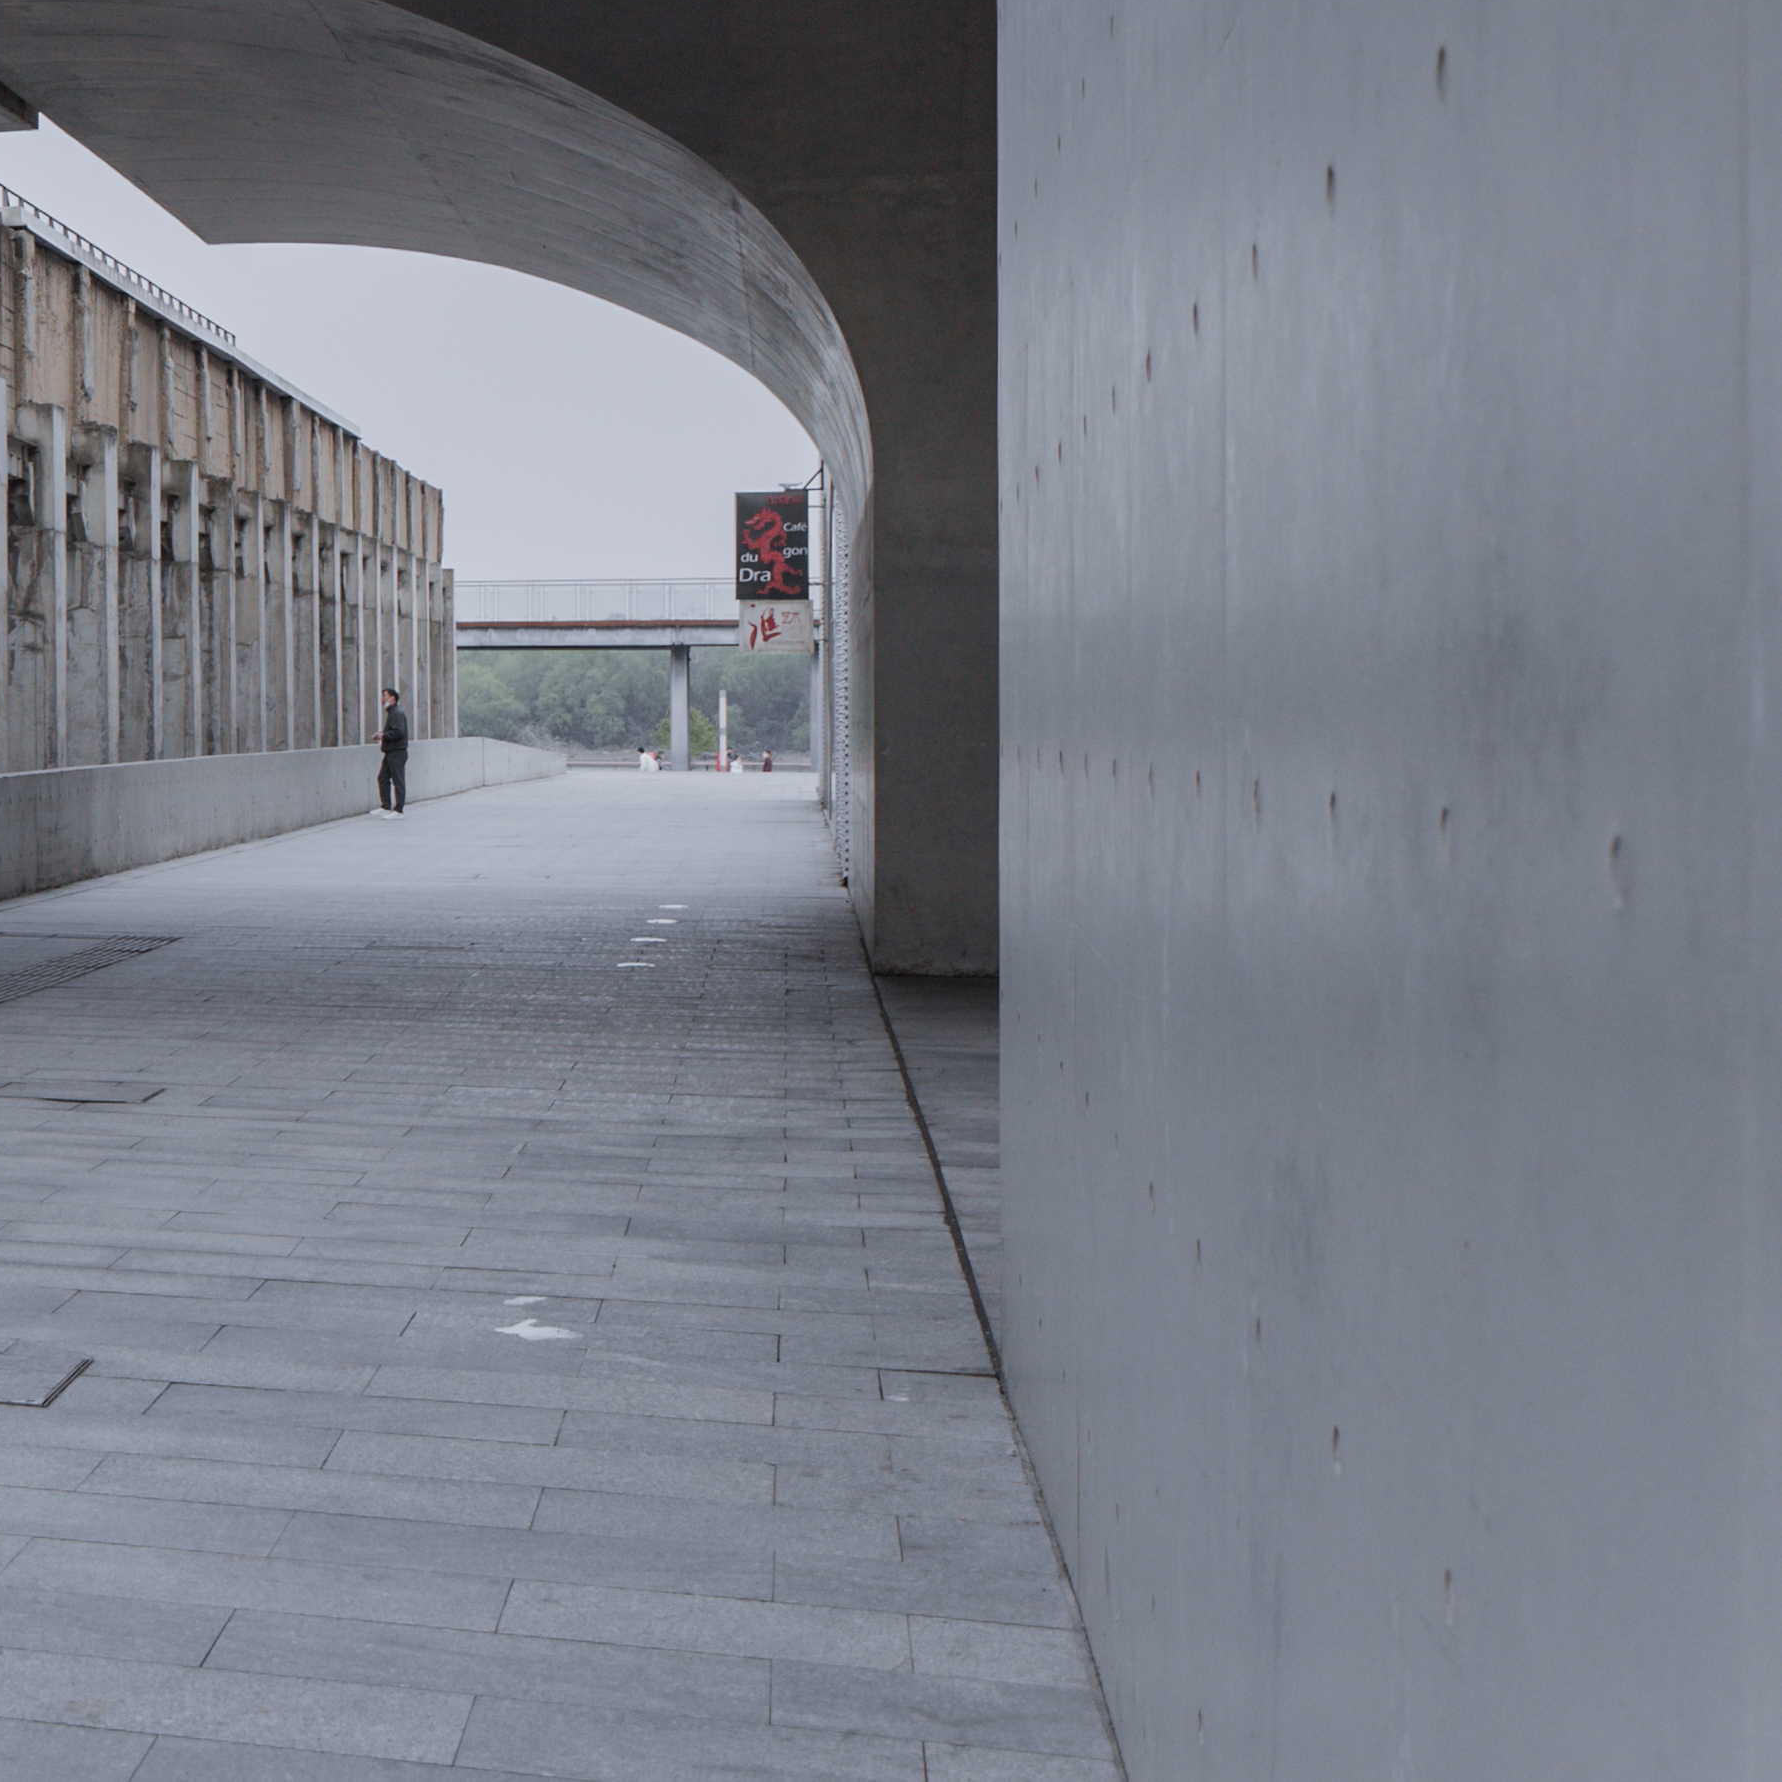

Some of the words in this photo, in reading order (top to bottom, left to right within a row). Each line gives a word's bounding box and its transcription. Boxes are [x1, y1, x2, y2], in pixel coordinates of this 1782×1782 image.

[783, 521, 808, 532] Café
[740, 552, 758, 563] du
[782, 546, 808, 558] gon
[739, 568, 771, 583] Dra
